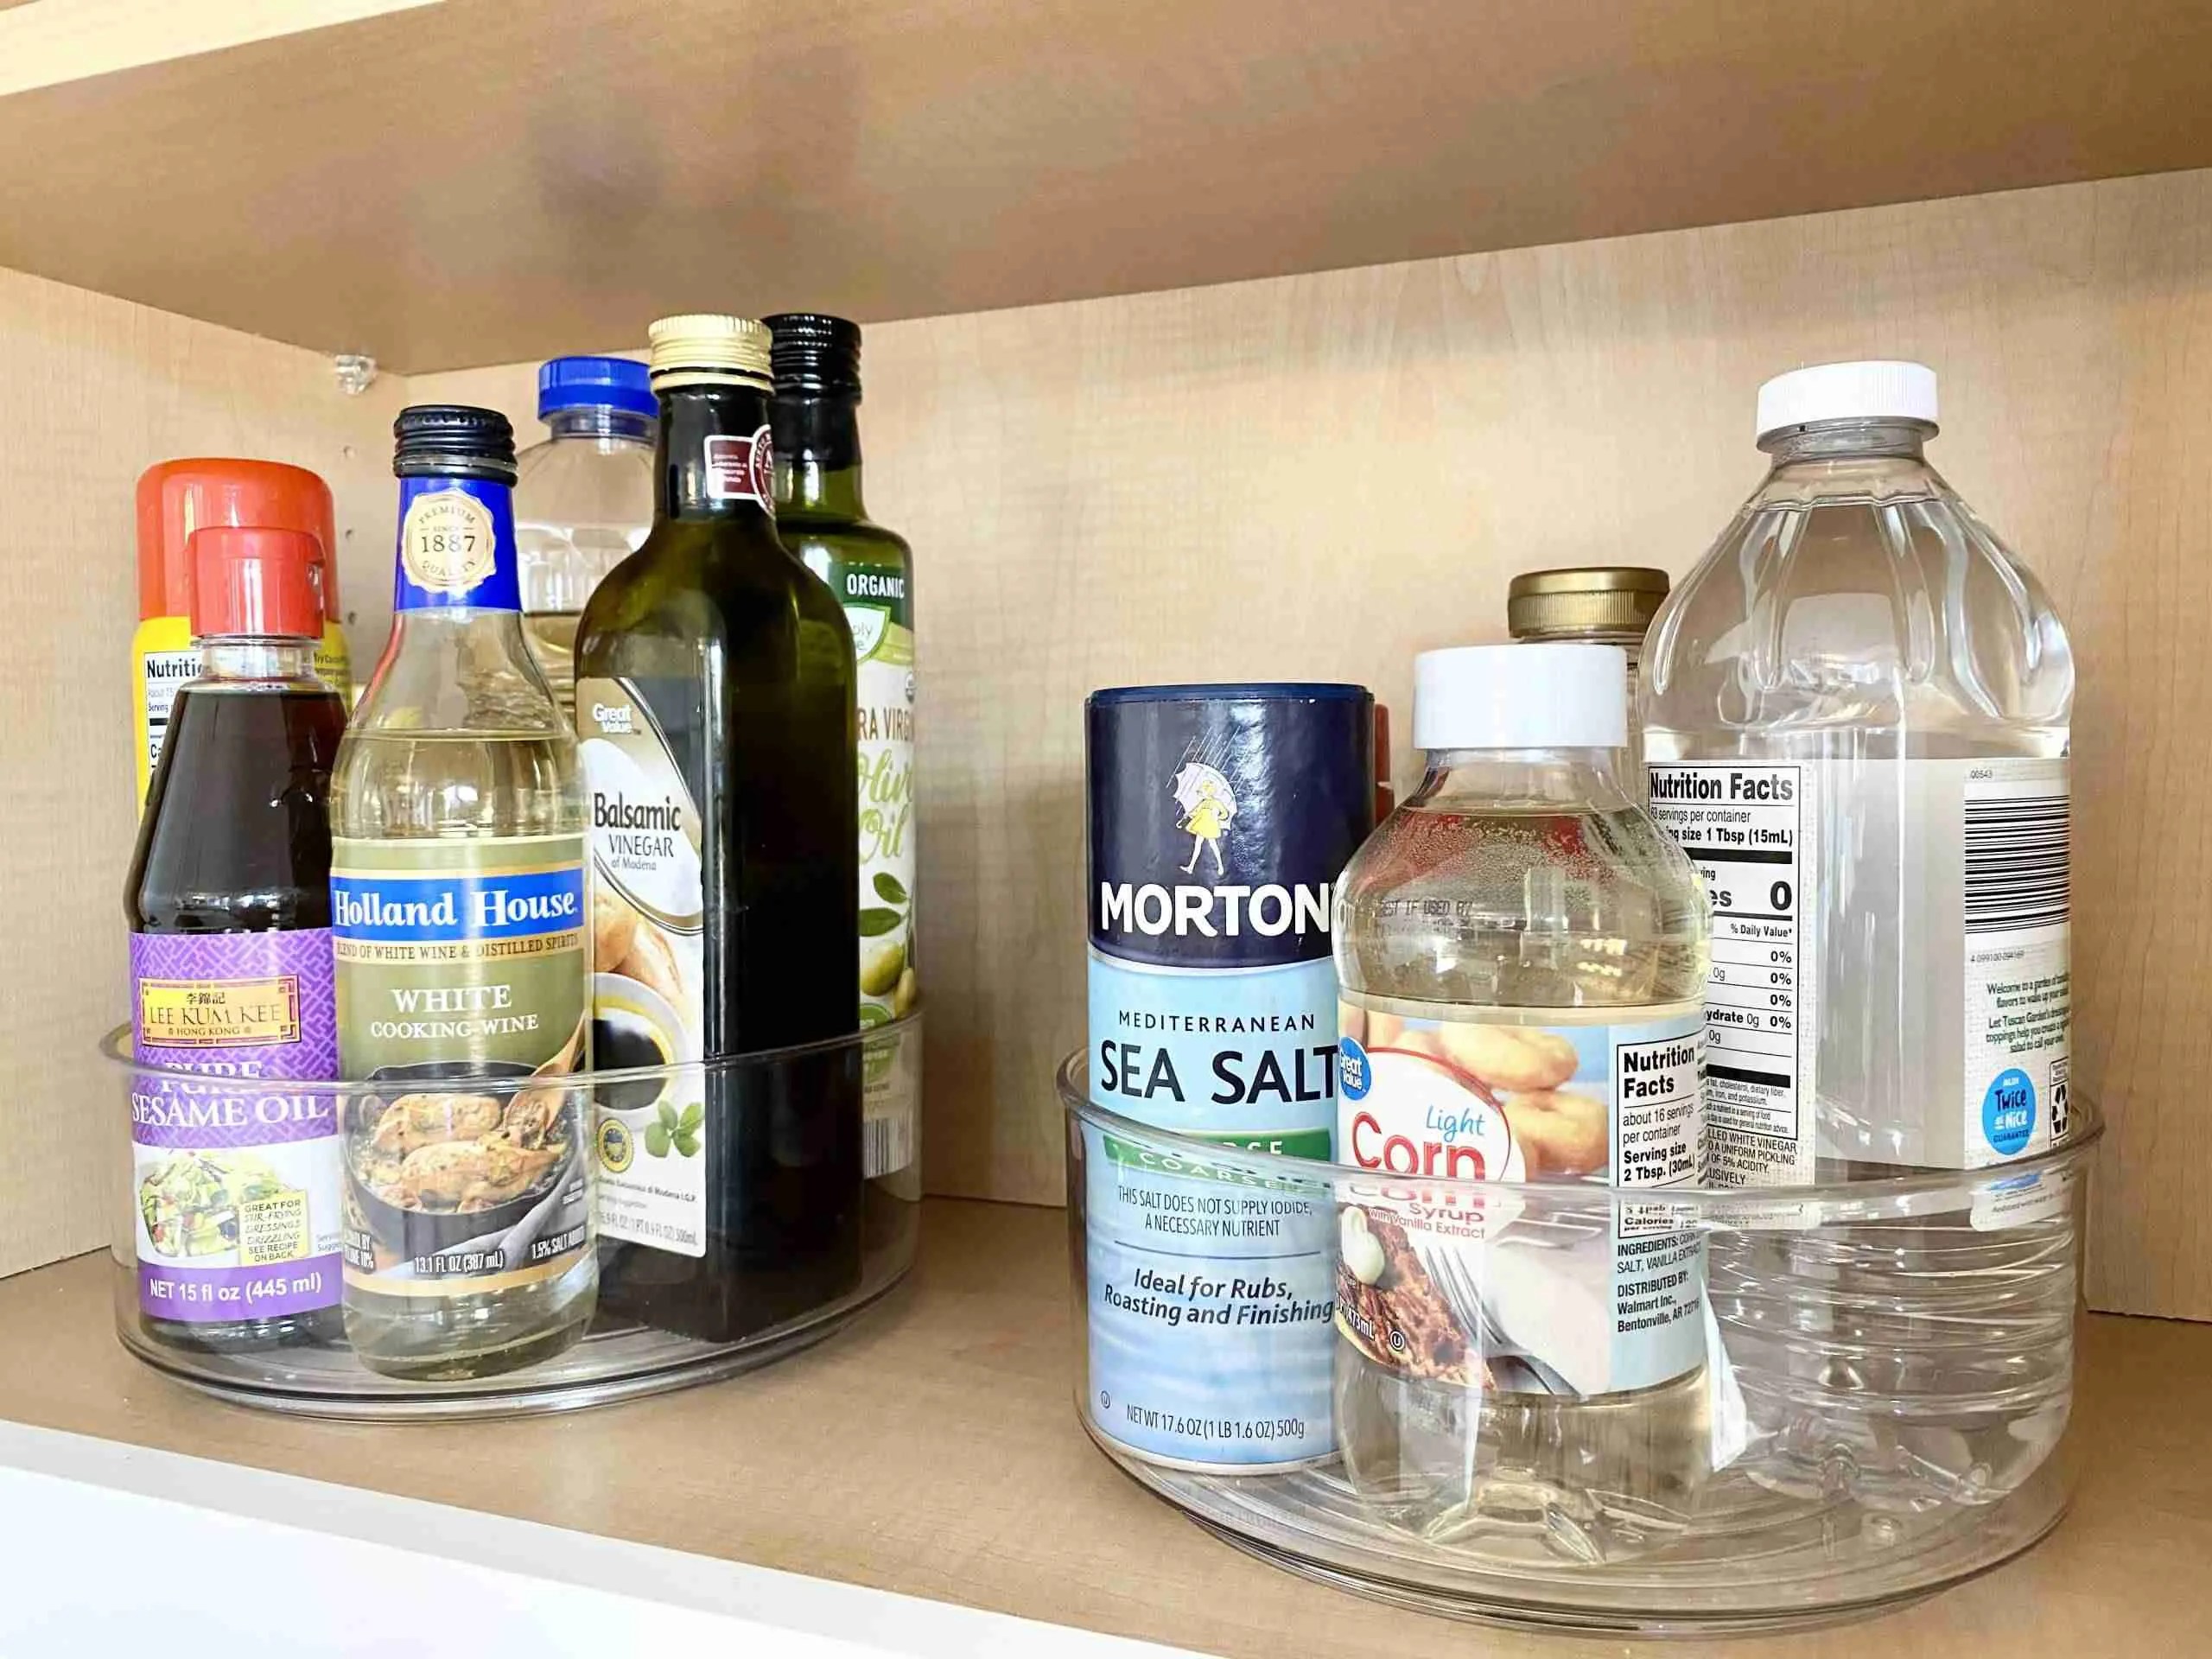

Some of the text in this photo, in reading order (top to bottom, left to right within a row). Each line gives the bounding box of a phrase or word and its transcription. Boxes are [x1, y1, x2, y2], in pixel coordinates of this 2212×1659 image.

[419, 505, 475, 524] PREMIUM
[422, 534, 476, 553] 1887
[422, 561, 476, 576] QUALTY
[847, 573, 905, 598] ORGANIC
[593, 702, 630, 721] Great
[1650, 772, 1793, 800] Nutrition Facts
[594, 791, 681, 831] Balsamic
[1659, 808, 1751, 823] servings per container
[608, 834, 674, 858] VINEGAR
[1681, 826, 1701, 841] size
[1707, 828, 1712, 842] 1
[1716, 827, 1745, 845] Tbsp
[1749, 828, 1793, 847] (15mL)
[611, 856, 657, 871] of Modena
[1770, 880, 1793, 911] 0
[334, 889, 576, 927] Holland House
[1101, 881, 1330, 937] MORTON
[1740, 925, 1761, 938] Daily
[359, 933, 579, 959] OF WHITE WINE & DISTILLED SPIRITS
[1770, 950, 1792, 963] 0%
[1713, 967, 1792, 985] 0g 0%
[391, 984, 512, 1014] WHITE
[1770, 994, 1792, 1007] 0%
[149, 1004, 281, 1026] LEE KUM KEE
[371, 1014, 539, 1039] COOKING WINE
[1119, 1009, 1315, 1033] MEDITERRANEAN
[1746, 1013, 1759, 1028] 0g
[1770, 1015, 1792, 1029] 0%
[175, 1027, 241, 1037] HONG KONG
[1708, 1029, 1721, 1044] 0g
[1624, 1045, 1694, 1073] Nutrition
[1101, 1039, 1338, 1105] SEA SALT
[1624, 1075, 1675, 1099] Facts
[131, 1092, 329, 1128] SESAME OIL
[1994, 1089, 2027, 1112] Twice
[1426, 1105, 1485, 1143] Light
[1623, 1111, 1651, 1127] about
[1654, 1108, 1665, 1122] 16
[1666, 1102, 1694, 1121] servings
[1352, 1111, 1485, 1182] Corn
[1623, 1124, 1681, 1147] per container
[1729, 1130, 1756, 1147] WHITE
[1624, 1141, 1687, 1165] Serving size
[1721, 1142, 1756, 1159] UNIFORM
[1758, 1150, 1796, 1166] PICKLING
[1624, 1154, 1695, 1182] 2 Tbsp. (30mL)
[245, 1198, 302, 1213] GREAT FOR
[1118, 1185, 1313, 1217] THIS SALT DOES NOT SUPPLY IODIDE,
[1145, 1214, 1280, 1237] A NECESSARY NUTRIENT
[1409, 1202, 1485, 1226] Syrup
[1624, 1217, 1675, 1225] Calories
[1436, 1222, 1485, 1239] Extract
[267, 1241, 298, 1253] RECIPE
[269, 1250, 295, 1261] BACK
[1618, 1236, 1679, 1257] INGREDIENTS:
[415, 1255, 433, 1273] 13.1
[435, 1256, 447, 1273] FL
[448, 1255, 461, 1272] OZ
[463, 1252, 484, 1273] (387
[150, 1272, 322, 1305] NET 15 fl oz (445 ml)
[1134, 1268, 1293, 1302] Ideal for Rubs,
[1618, 1274, 1677, 1298] DISTRIBUTED
[1104, 1284, 1181, 1327] Roasting
[1186, 1303, 1232, 1325] and
[1236, 1300, 1335, 1325] Finishing
[1618, 1297, 1659, 1315] Walmart
[1618, 1306, 1683, 1333] Bentonville, AR
[1127, 1404, 1142, 1426] NET
[1144, 1408, 1160, 1429] WT
[1161, 1412, 1185, 1434] 17.6
[1186, 1415, 1203, 1436] OZ
[1218, 1420, 1231, 1439] LB
[1237, 1420, 1253, 1440] 1.6
[1255, 1420, 1275, 1441] OZ)
[1277, 1418, 1305, 1440] 500g
